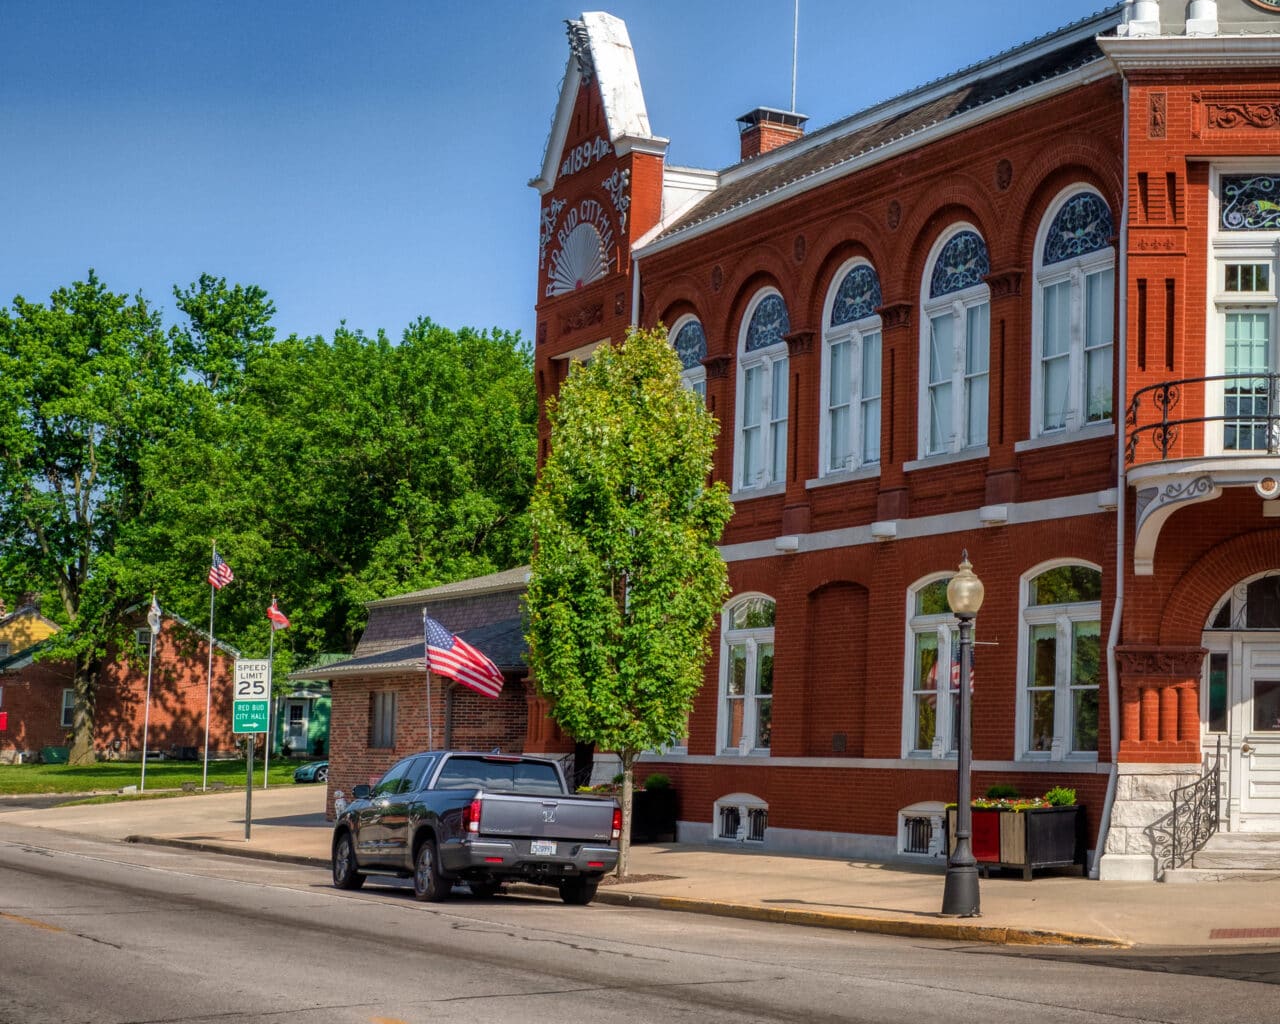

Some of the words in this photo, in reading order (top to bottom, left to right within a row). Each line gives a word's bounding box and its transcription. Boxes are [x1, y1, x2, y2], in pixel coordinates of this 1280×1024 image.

[570, 136, 602, 175] 1894
[557, 207, 578, 248] BUD
[580, 199, 604, 225] CITY
[239, 681, 265, 695] 25
